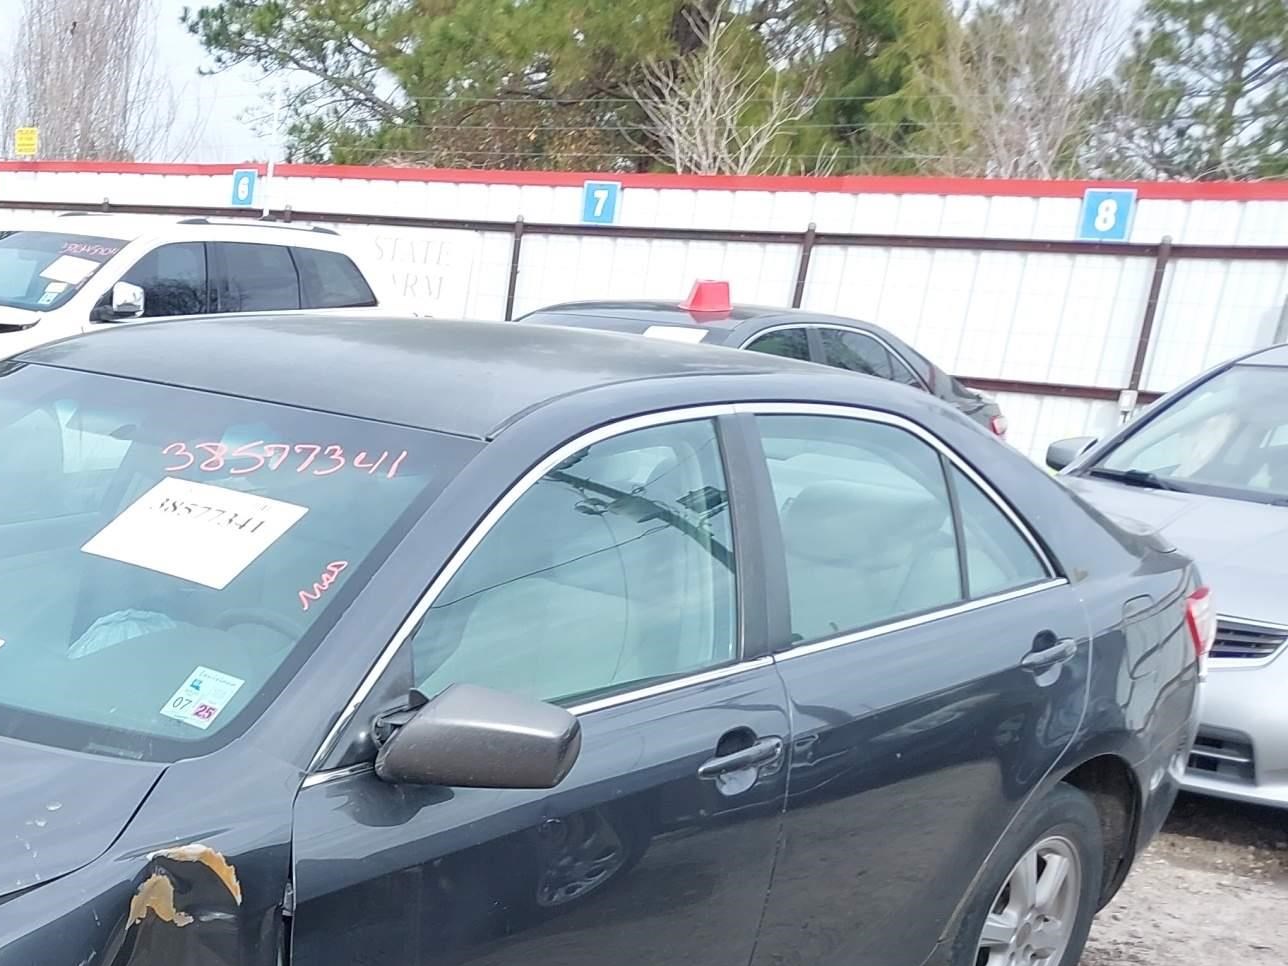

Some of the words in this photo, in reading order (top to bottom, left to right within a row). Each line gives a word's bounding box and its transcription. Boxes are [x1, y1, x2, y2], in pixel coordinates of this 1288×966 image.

[238, 176, 249, 201] 6
[594, 189, 609, 217] 7
[1095, 199, 1118, 231] 8
[375, 235, 451, 266] STATE
[162, 440, 408, 479] 38577341
[160, 497, 265, 534] 38577341
[172, 696, 193, 711] 07
[193, 703, 217, 719] 25
